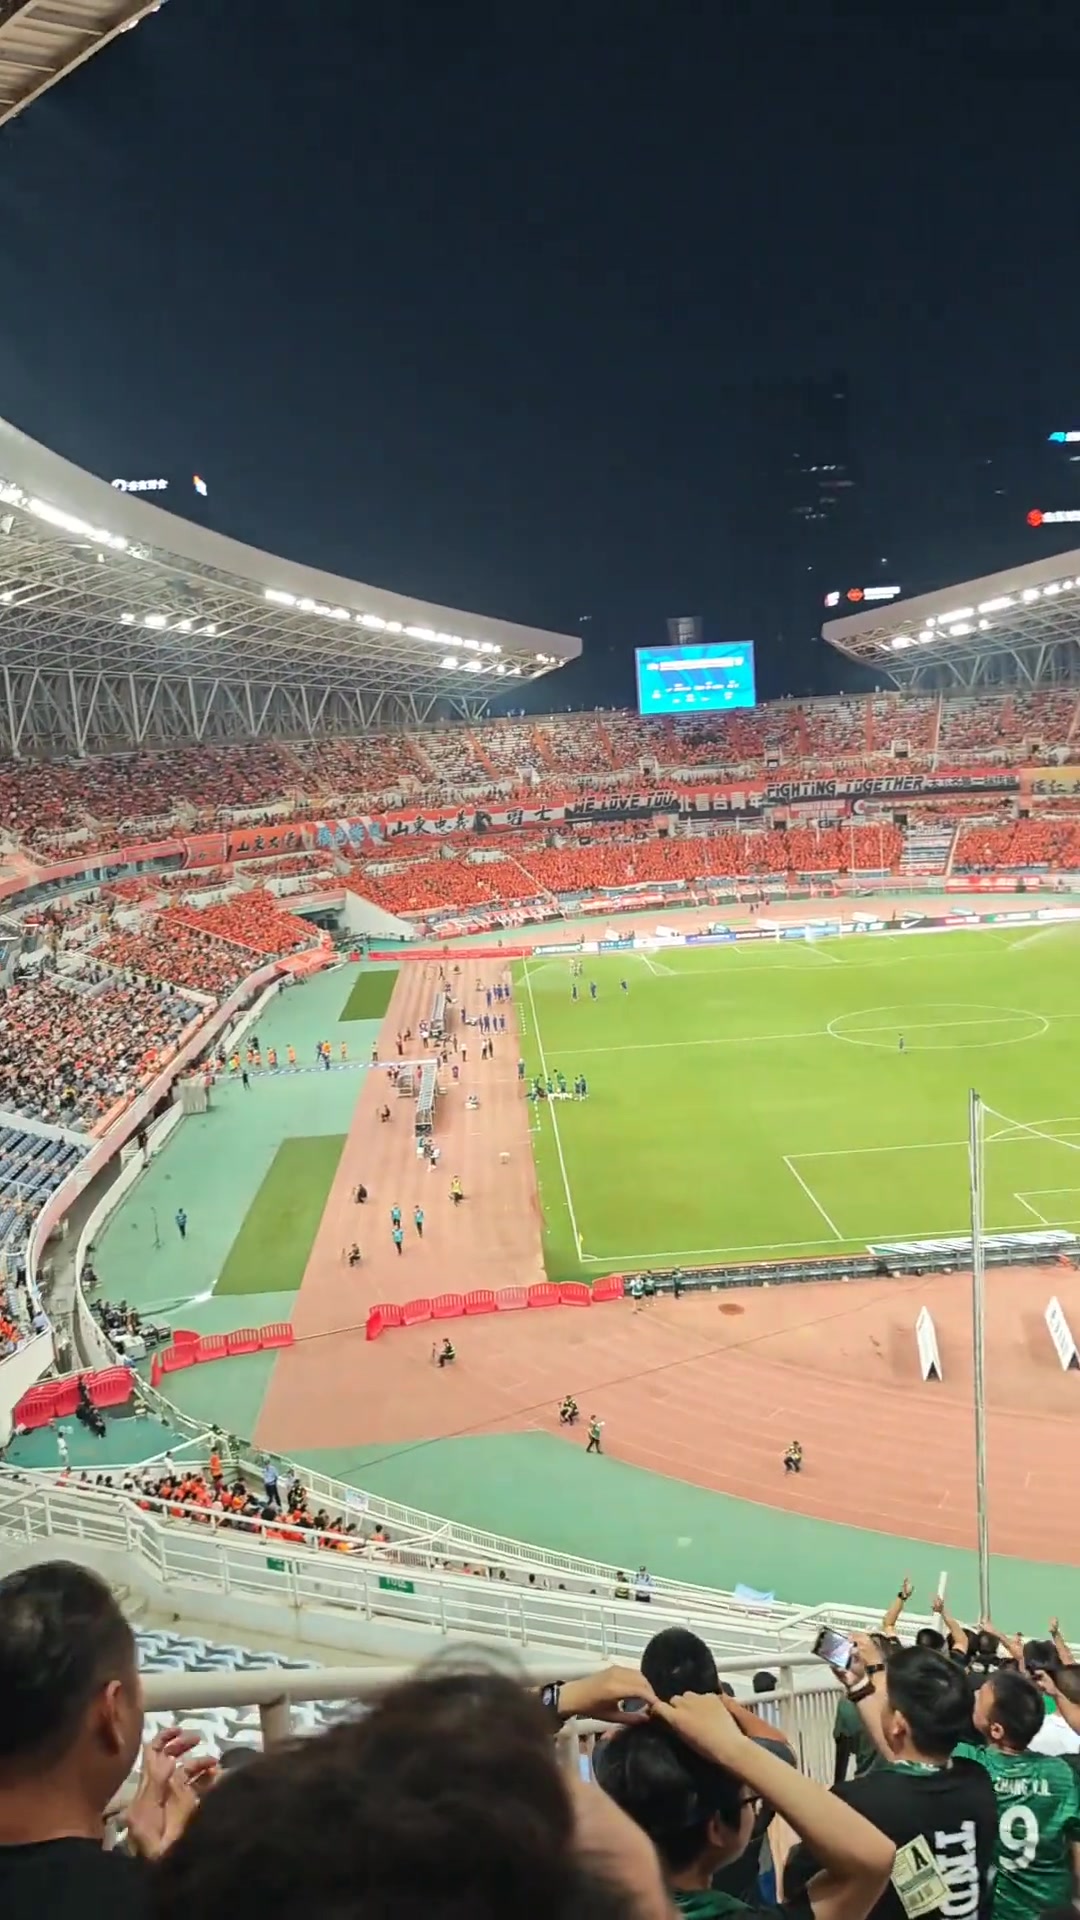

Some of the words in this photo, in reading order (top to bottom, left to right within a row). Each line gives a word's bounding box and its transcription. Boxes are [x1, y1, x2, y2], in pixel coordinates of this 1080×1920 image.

[845, 775, 926, 794] TOGETHER
[574, 796, 595, 813] WE
[601, 793, 640, 811] LOVE
[999, 1805, 1038, 1869] 9
[911, 1845, 929, 1871] A
